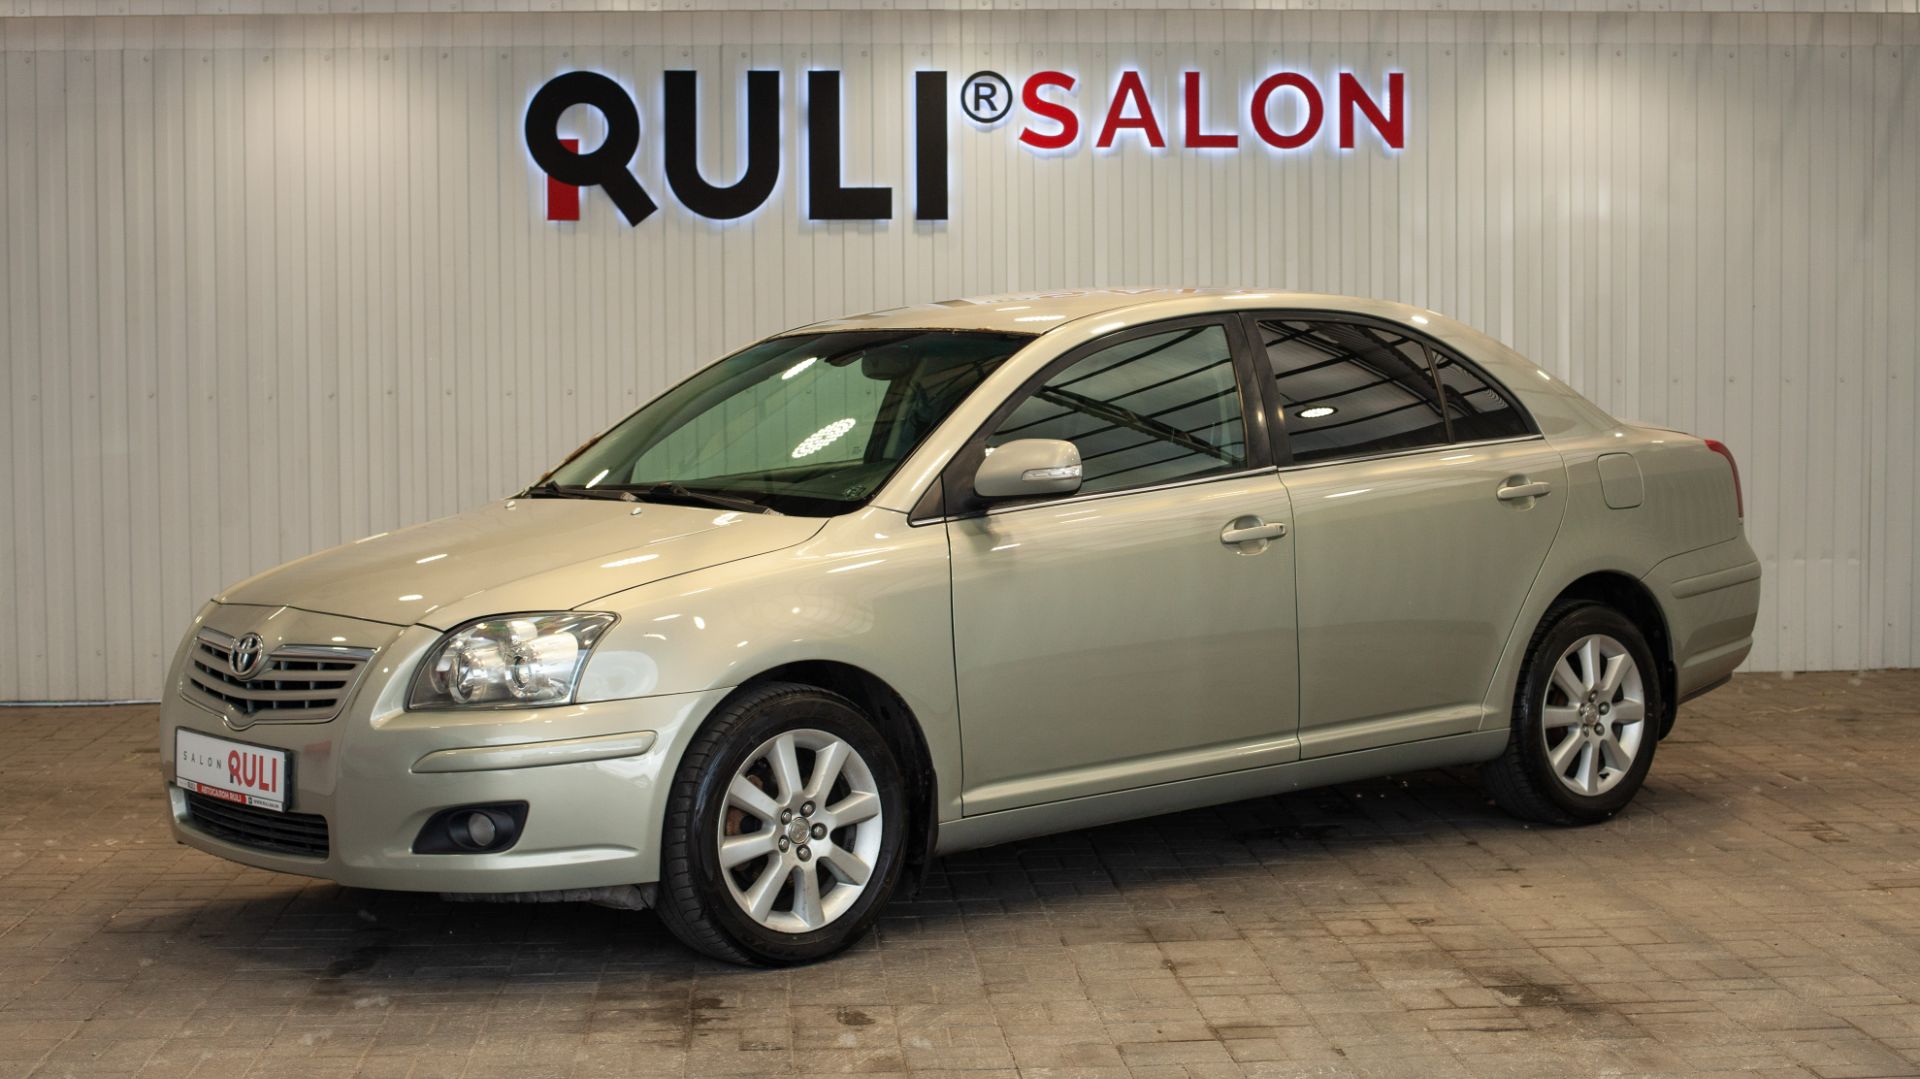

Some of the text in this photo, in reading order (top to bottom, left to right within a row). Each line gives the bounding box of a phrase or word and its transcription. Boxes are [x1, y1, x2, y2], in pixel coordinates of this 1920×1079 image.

[1019, 70, 1404, 150] SALON
[183, 750, 277, 793] SALON RULI
